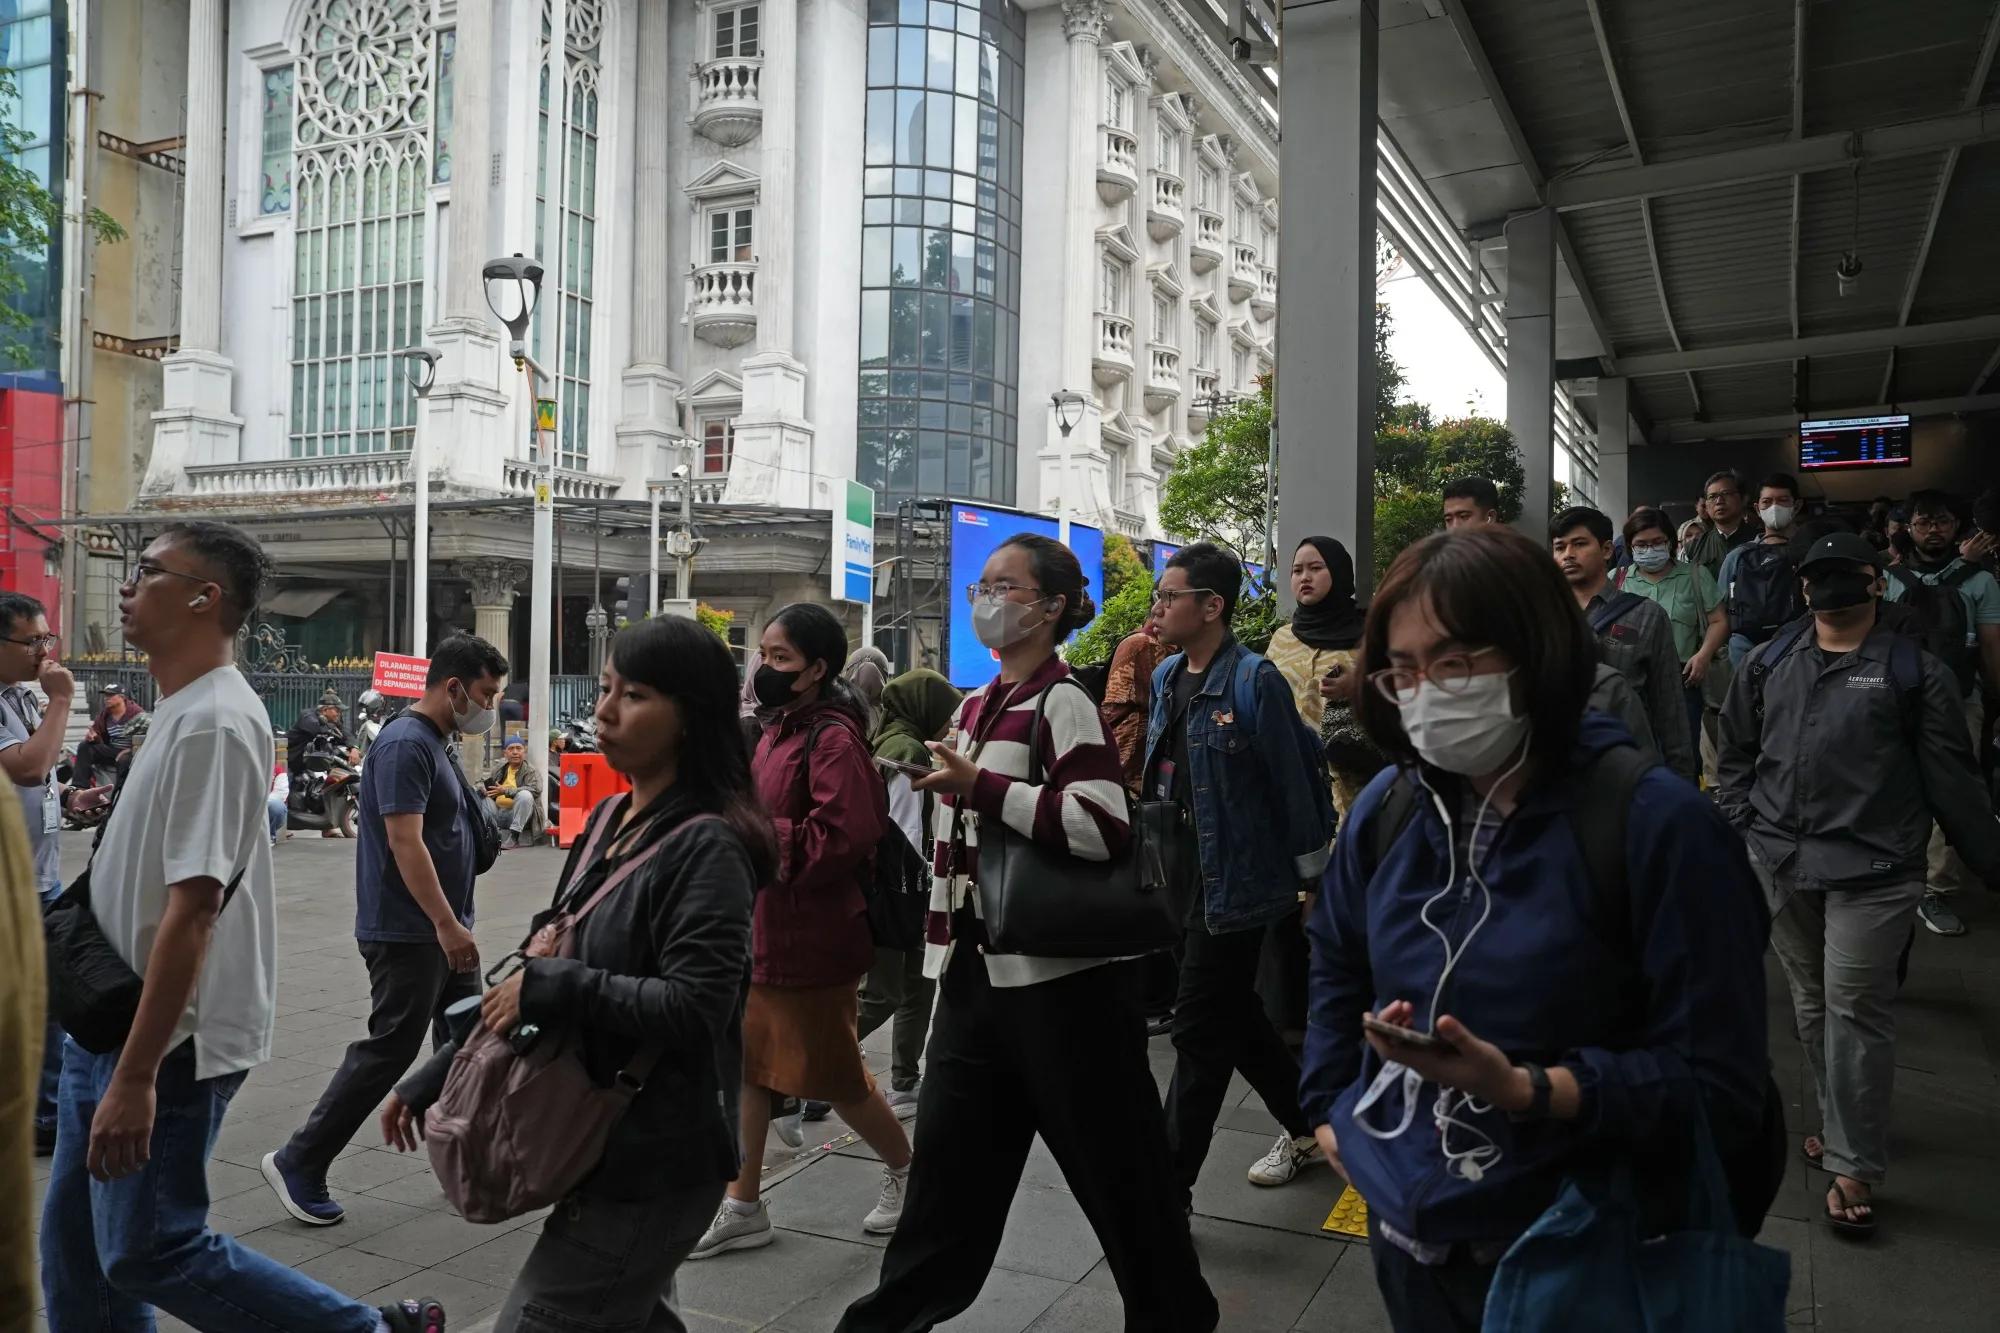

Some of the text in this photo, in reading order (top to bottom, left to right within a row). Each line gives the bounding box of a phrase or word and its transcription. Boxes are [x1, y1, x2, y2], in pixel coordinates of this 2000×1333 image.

[846, 533, 871, 554] FamilyMart
[380, 661, 411, 670] DILARANG
[383, 680, 418, 690] SEPANJANG
